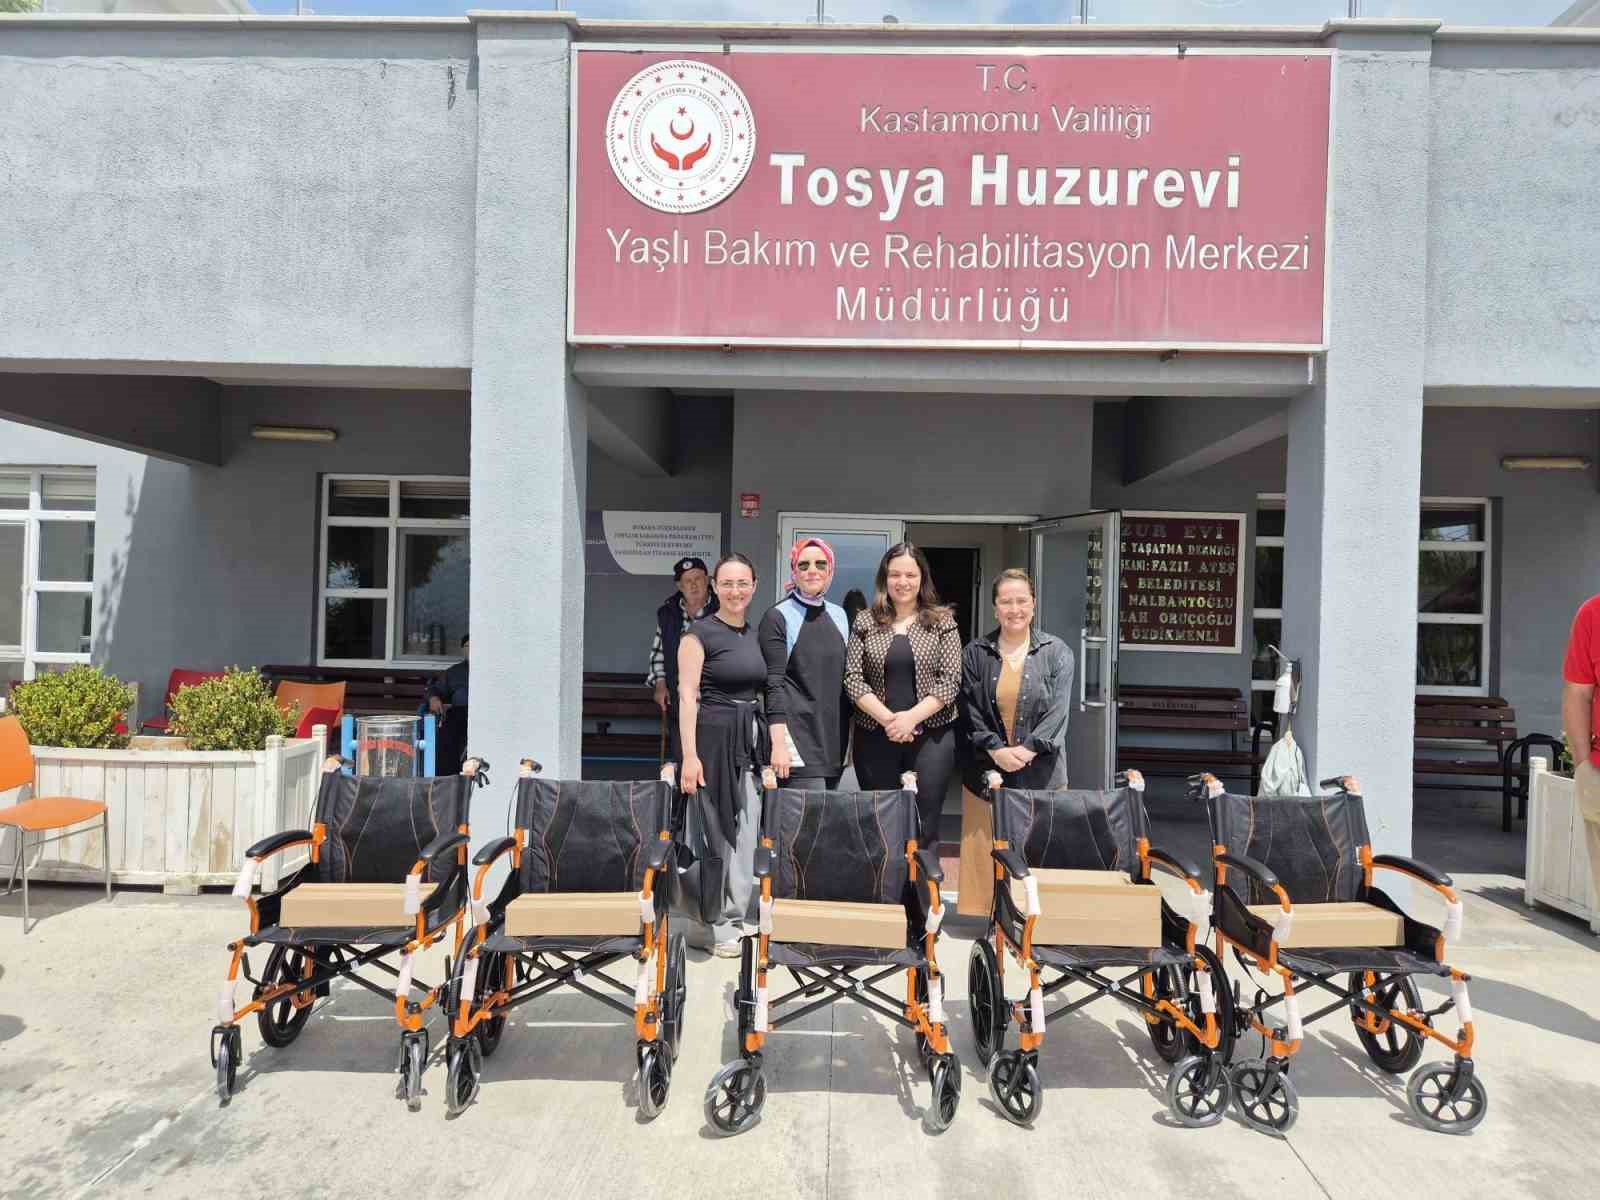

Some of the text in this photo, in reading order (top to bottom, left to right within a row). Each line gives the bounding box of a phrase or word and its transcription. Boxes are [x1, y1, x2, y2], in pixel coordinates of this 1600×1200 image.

[976, 63, 1036, 93] T.C.
[859, 104, 1153, 140] Kastamonu Valiliği
[768, 152, 1243, 222] Tosya Huzurevi
[606, 227, 1312, 280] Yaşlı Bakım ve Rehabilitasyon Merkezi
[834, 286, 1072, 334] Müdürlüğü
[1131, 543, 1183, 556] YAŞATMA
